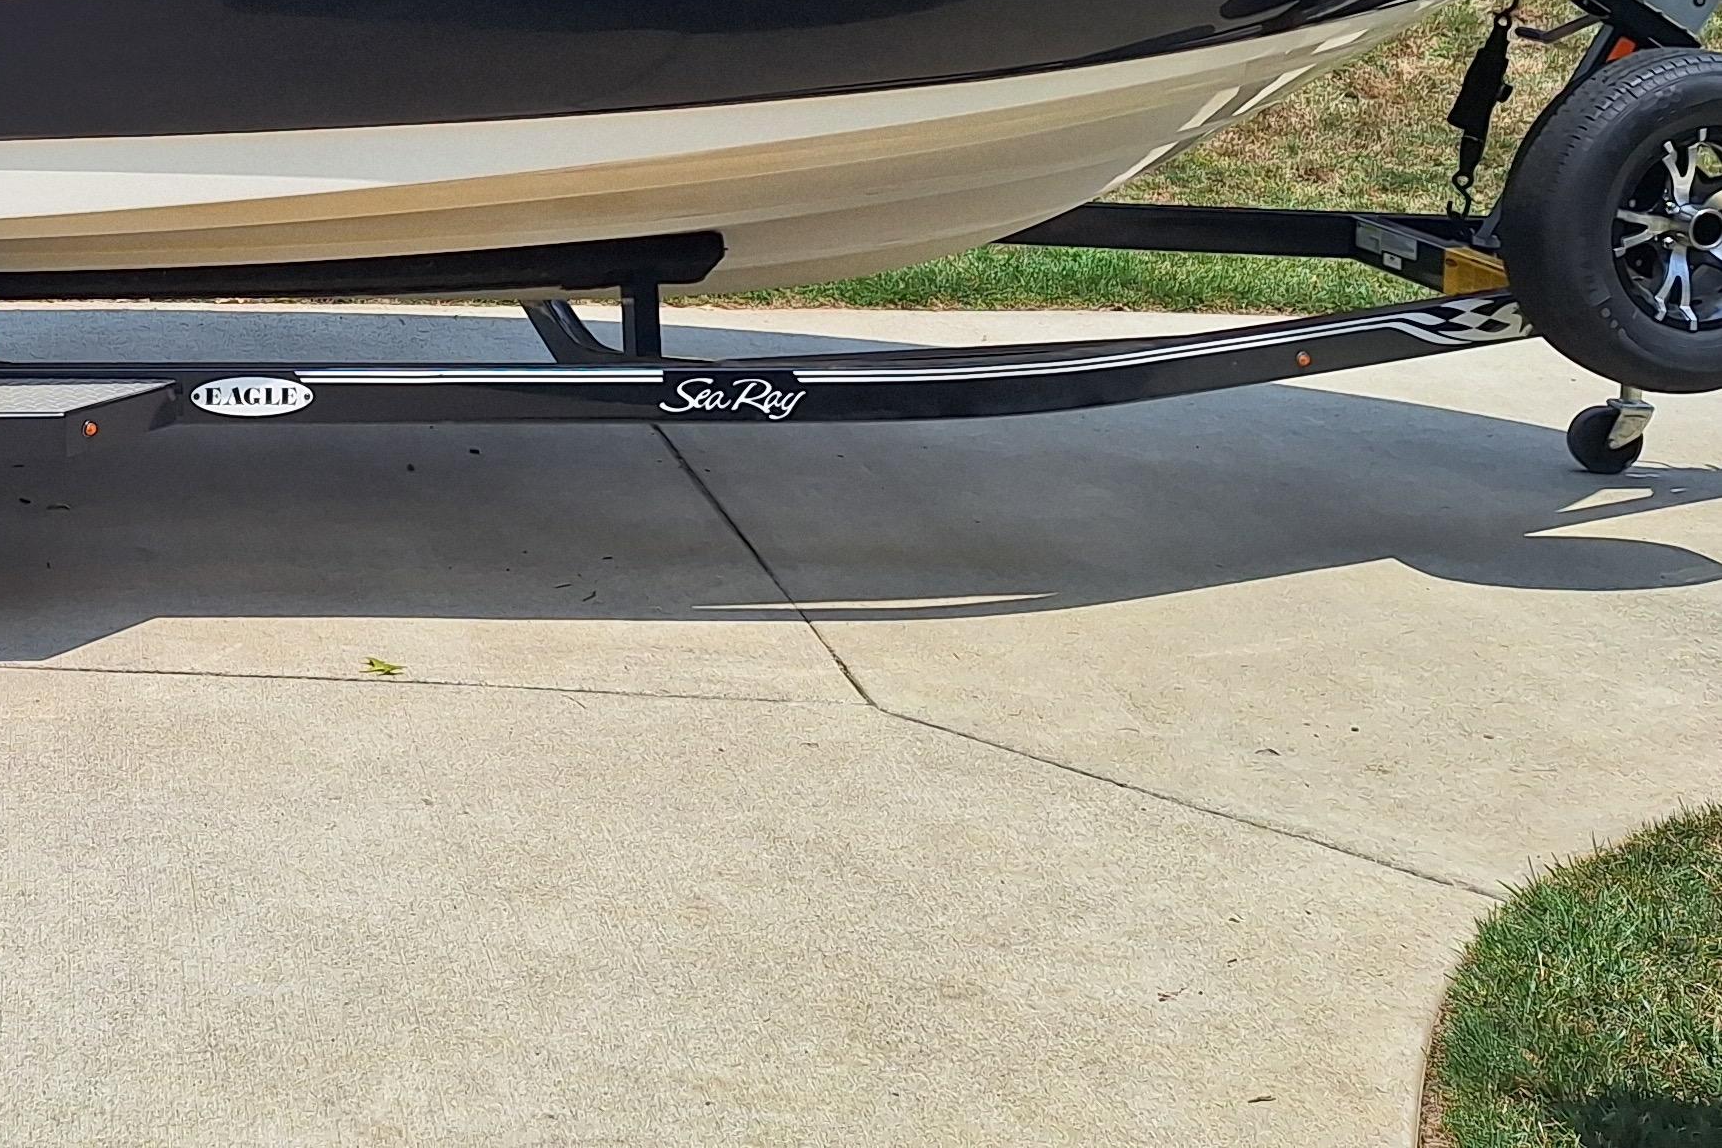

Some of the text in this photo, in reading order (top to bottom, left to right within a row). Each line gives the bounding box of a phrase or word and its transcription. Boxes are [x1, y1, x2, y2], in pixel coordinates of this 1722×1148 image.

[204, 386, 297, 406] EAGLE
[659, 377, 807, 420] Sea Ray
